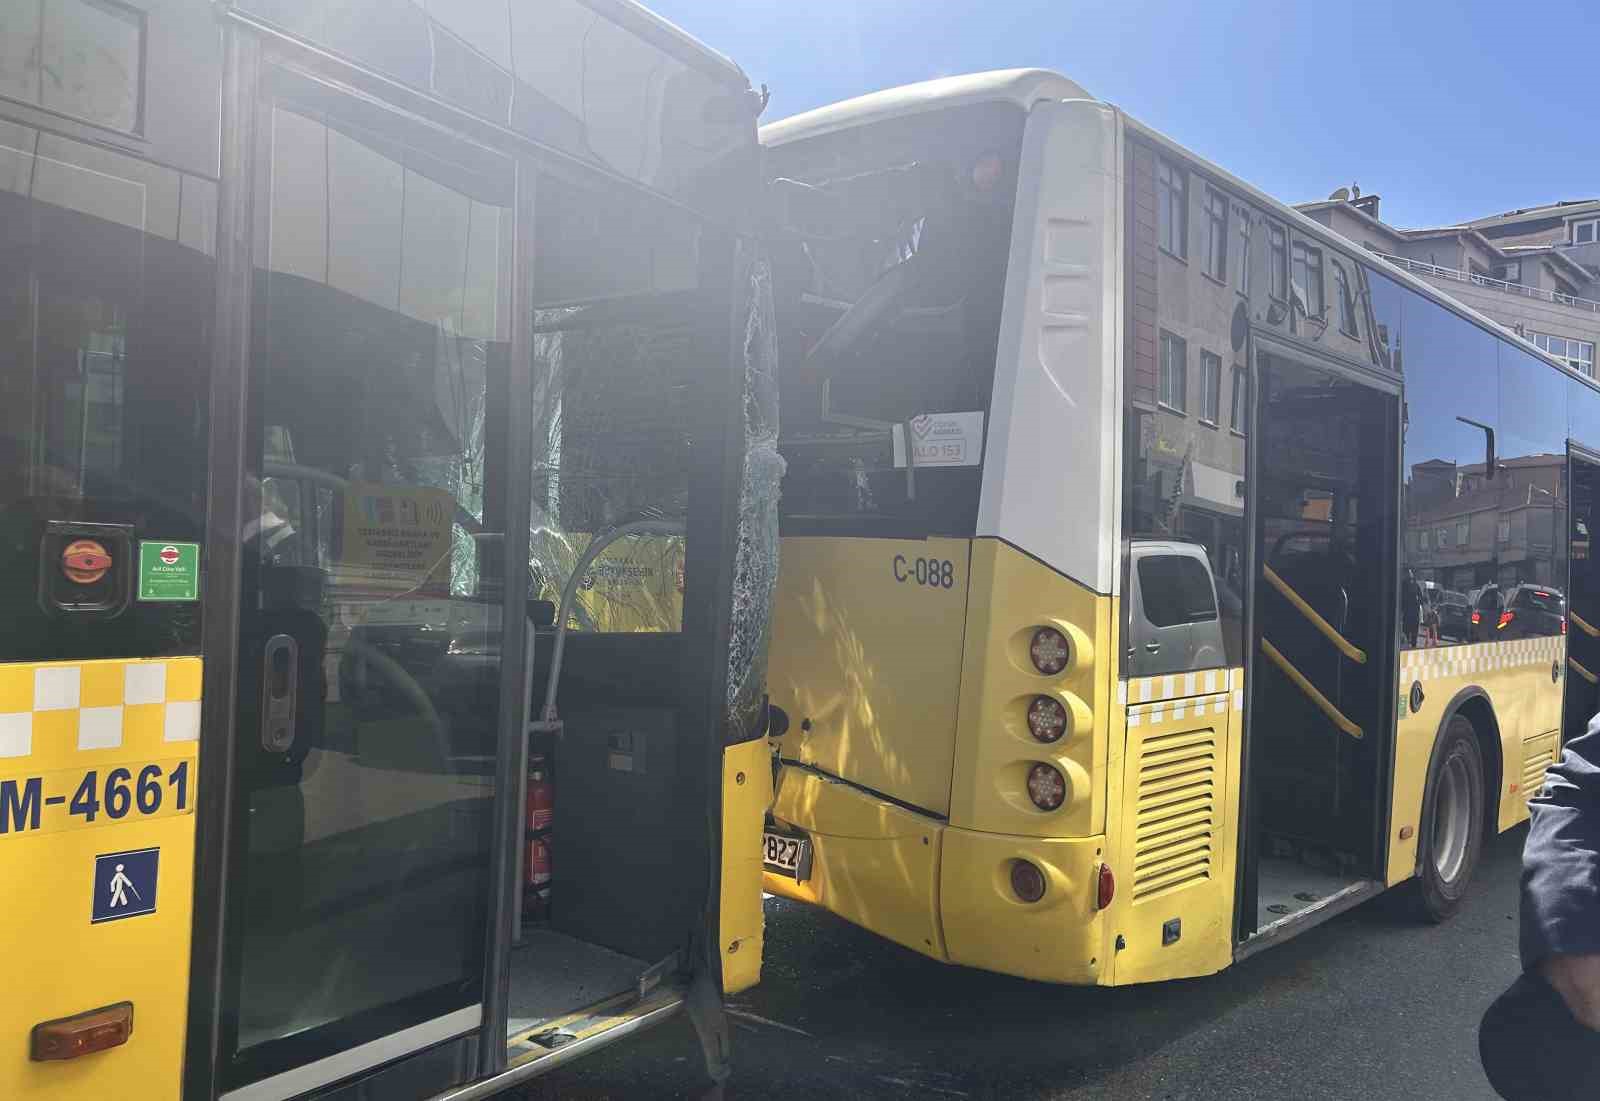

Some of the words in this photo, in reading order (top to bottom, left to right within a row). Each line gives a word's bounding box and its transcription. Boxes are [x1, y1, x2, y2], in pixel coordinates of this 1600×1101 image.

[943, 445, 961, 457] 153
[893, 554, 954, 589] C-088
[0, 761, 188, 834] M-4661
[763, 836, 797, 866] 822
